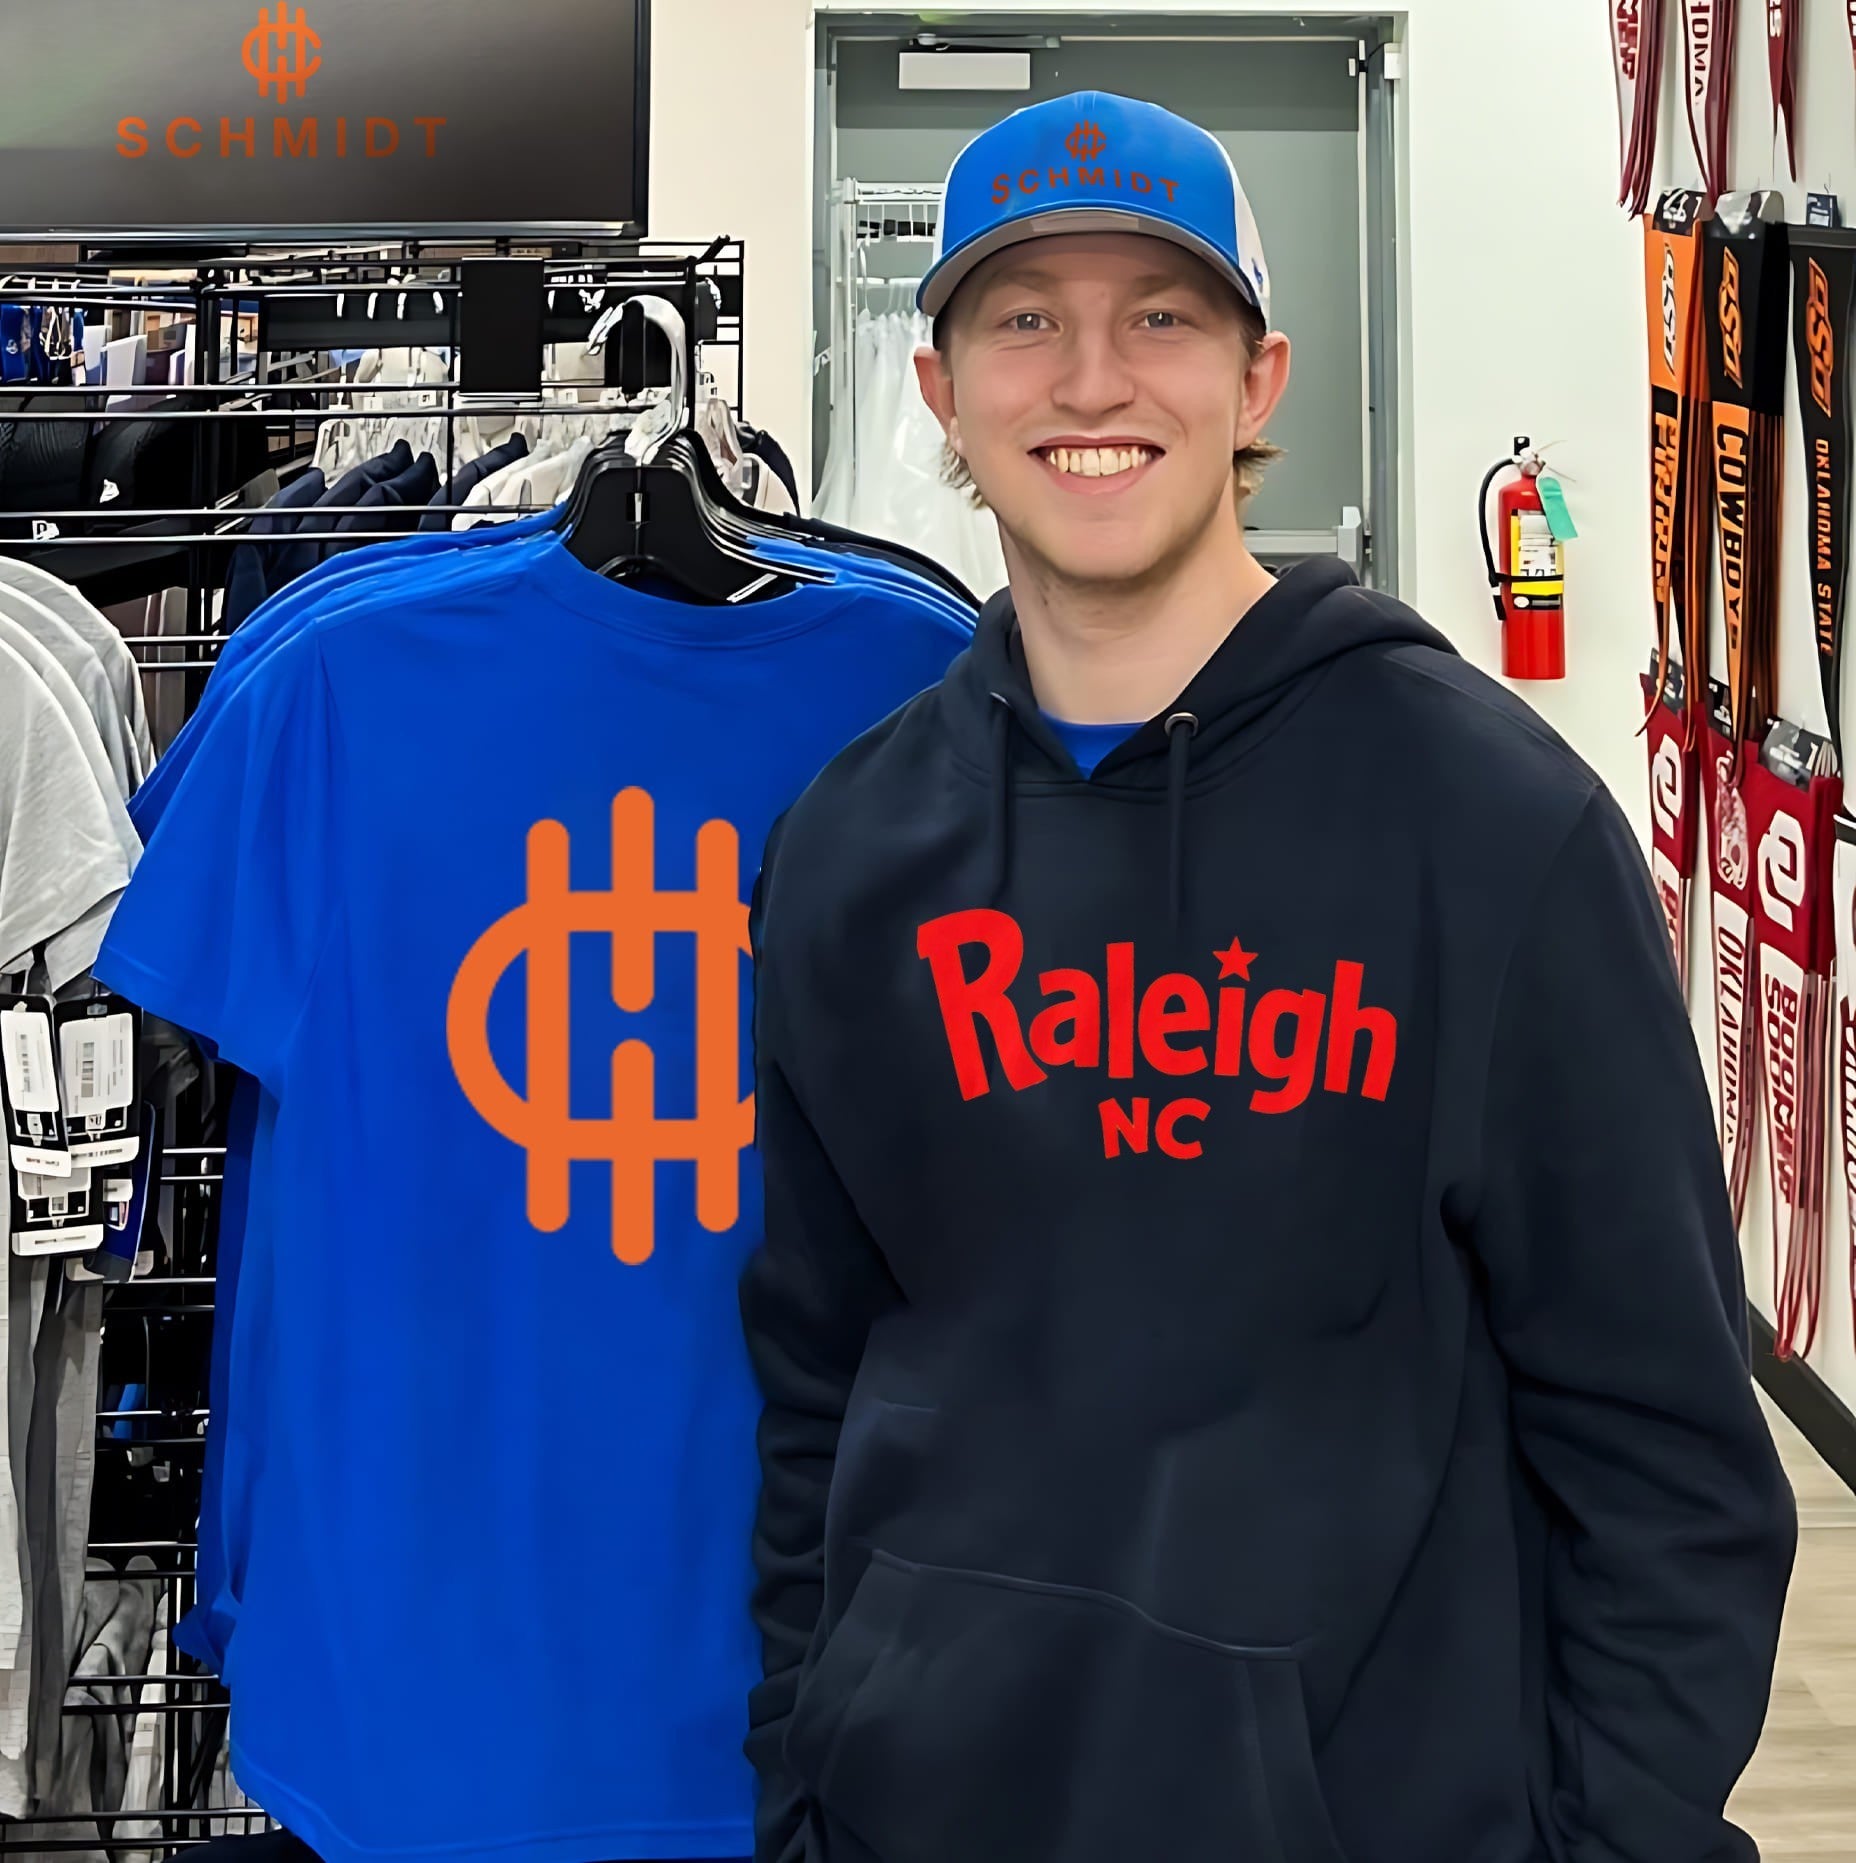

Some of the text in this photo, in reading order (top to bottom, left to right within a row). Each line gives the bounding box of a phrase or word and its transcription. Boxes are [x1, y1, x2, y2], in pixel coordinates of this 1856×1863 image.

[115, 116, 448, 160] SCHMIDT
[992, 167, 1179, 205] SCHMIDT
[916, 908, 1398, 1114] Raleigh
[1098, 1097, 1211, 1160] NC
